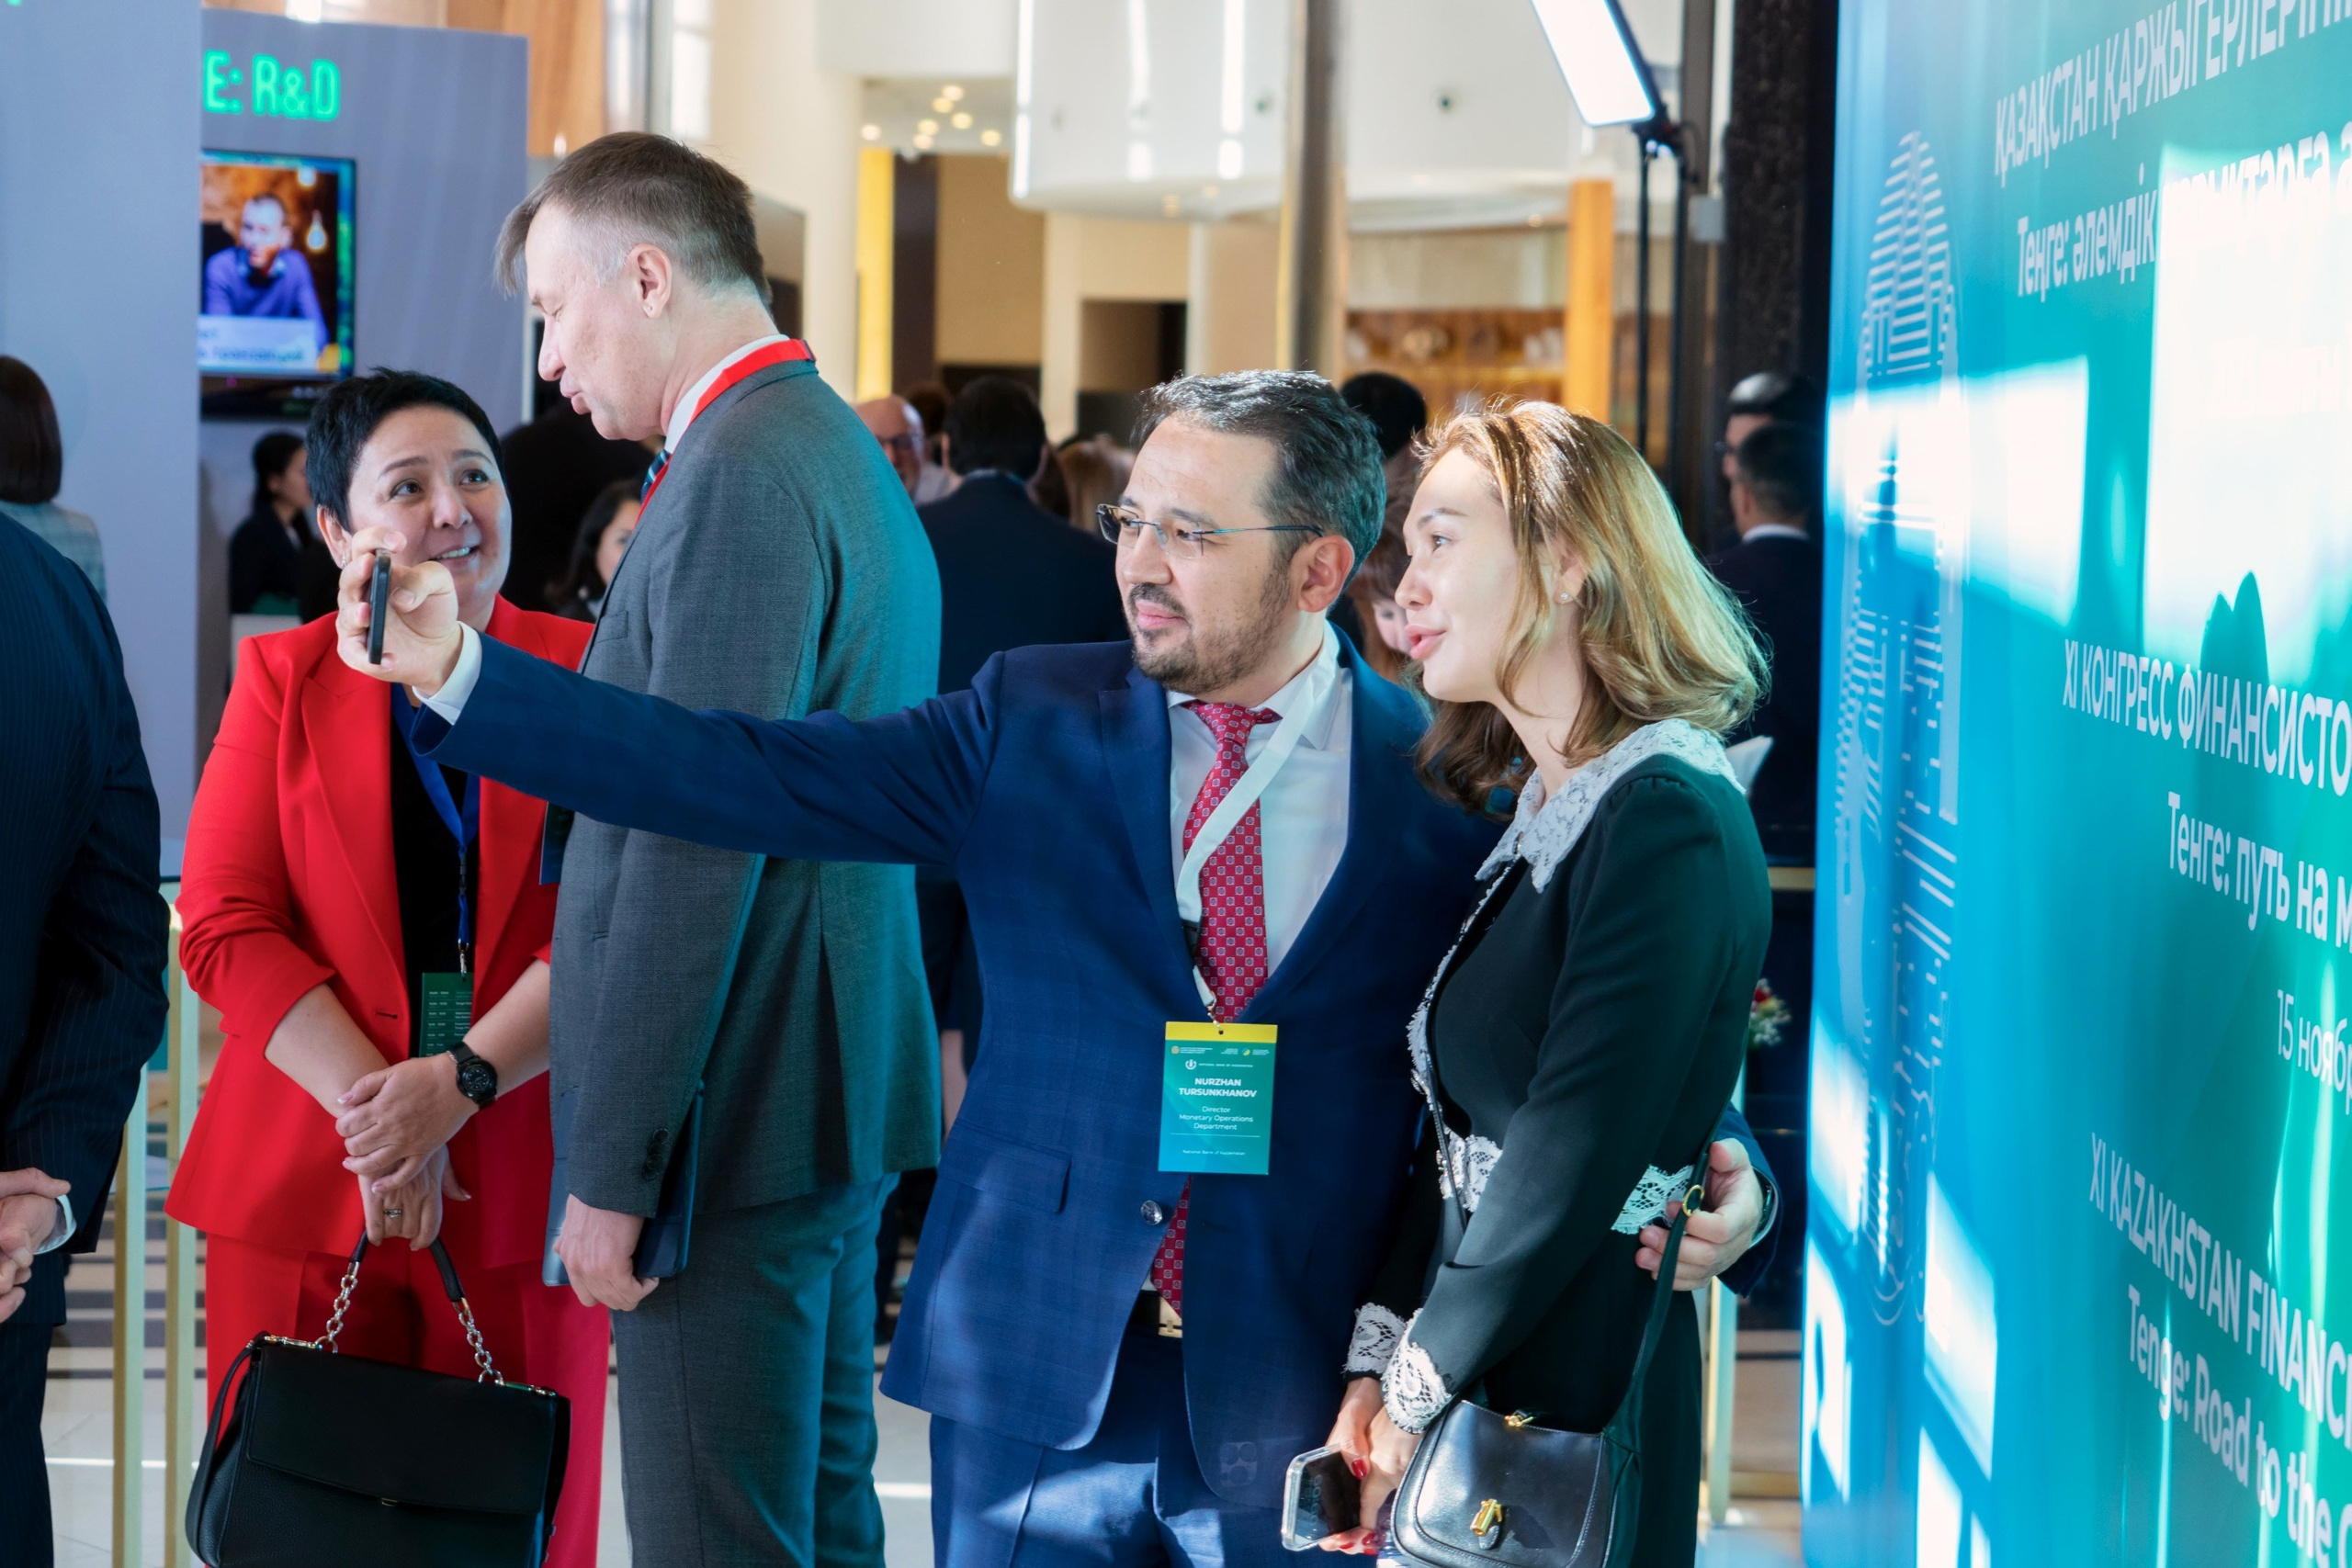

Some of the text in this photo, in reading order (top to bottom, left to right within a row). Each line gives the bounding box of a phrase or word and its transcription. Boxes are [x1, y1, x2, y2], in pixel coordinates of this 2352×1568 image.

[253, 53, 340, 120] R&D
[1995, 45, 2100, 188] ҚАЗАҚСТАН
[2018, 216, 2070, 302] Теңге:
[2073, 162, 2158, 285] әлемдік
[2063, 638, 2078, 709] XI
[2081, 643, 2175, 740] КОНГРЕСС
[2168, 791, 2232, 897] Тенге:
[2235, 836, 2290, 931] путь
[2297, 860, 2329, 942] на
[2277, 988, 2295, 1061] 15
[1179, 1088, 1258, 1098] TURSUNKHANOV
[1179, 1113, 1254, 1123] Monetary Operations
[1194, 1077, 1242, 1087] NURZHAN
[1202, 1105, 1231, 1113] Director
[1193, 1122, 1238, 1131] Department
[2089, 1132, 2107, 1213] XI
[2109, 1150, 2242, 1343] KAZAKHSTAN
[2128, 1284, 2332, 1568] Tenge: Road to the
